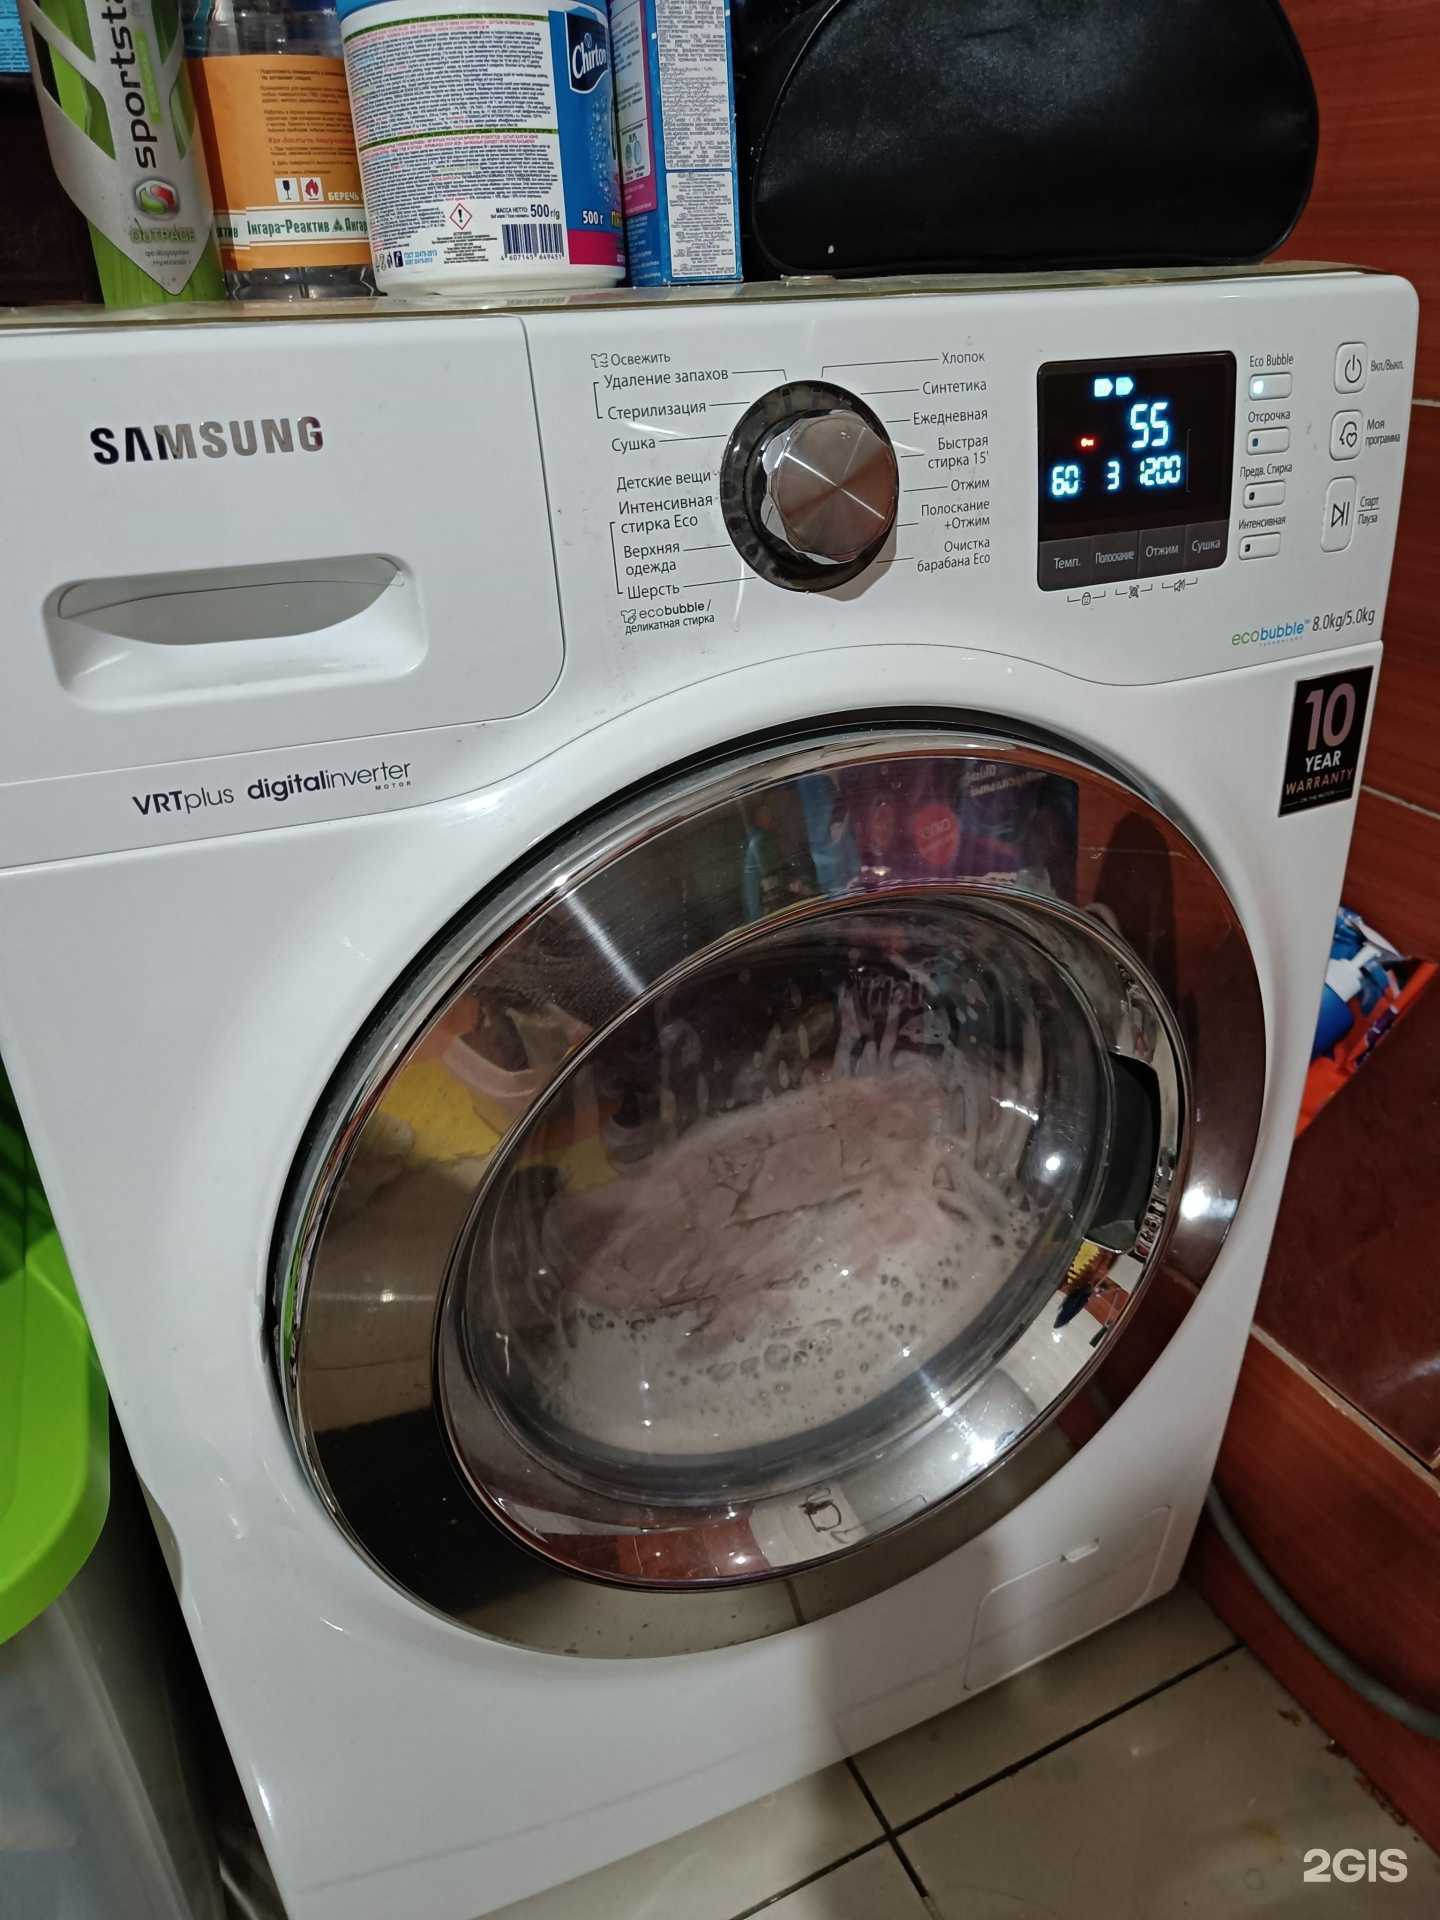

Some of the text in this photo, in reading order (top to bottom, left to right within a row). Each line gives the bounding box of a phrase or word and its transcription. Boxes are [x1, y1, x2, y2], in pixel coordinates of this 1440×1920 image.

[102, 0, 157, 168] sportst
[530, 204, 549, 217] 500
[582, 210, 599, 224] 500
[610, 352, 671, 366] Освежить
[942, 351, 986, 365] Хлопок
[1249, 353, 1294, 368] Eco Bubble
[604, 368, 729, 389] Удаление запахов
[922, 379, 987, 396] Синтетика
[607, 401, 707, 421] Стерилизация
[912, 407, 988, 426] Ежедневная
[1248, 410, 1291, 424] Отсрочка
[1130, 402, 1169, 449] 55
[1366, 418, 1386, 431] Моя
[90, 416, 324, 465] SAMSUNG
[611, 436, 656, 453] Сушка
[937, 434, 989, 452] Быстрая
[928, 454, 970, 469] стирка
[1240, 460, 1293, 479] Предв. Стирка
[616, 471, 711, 493] Детские вещи
[1051, 454, 1182, 496] 60 3 1200
[950, 477, 990, 492] Отжим
[618, 495, 713, 515] Интенсивная
[920, 499, 990, 517] Полоскание
[1359, 496, 1380, 509] Старт
[620, 514, 698, 535] стирка Eco
[943, 514, 990, 531] +Отжим
[1238, 515, 1287, 531] Интенсивная
[1358, 513, 1379, 526] Пауза
[623, 541, 680, 560] Верхняя
[944, 536, 990, 552] Очистка
[1145, 544, 1179, 558] Отжим
[1191, 538, 1221, 553] Сушка
[916, 552, 991, 573] барабана Eco
[1053, 556, 1081, 570] Темп.
[1095, 549, 1135, 565] Полоскание
[625, 559, 677, 577] одежда
[626, 583, 680, 600] Шерсть
[625, 614, 715, 634] деликатная стирка
[1312, 606, 1376, 632] 8.0kg/5.0kg
[1305, 682, 1356, 751] 10
[1305, 750, 1342, 773] YEAR
[132, 761, 411, 816] VRTplus digitalinverter
[375, 781, 412, 791] MOTOR
[1286, 768, 1354, 796] WARRANTY
